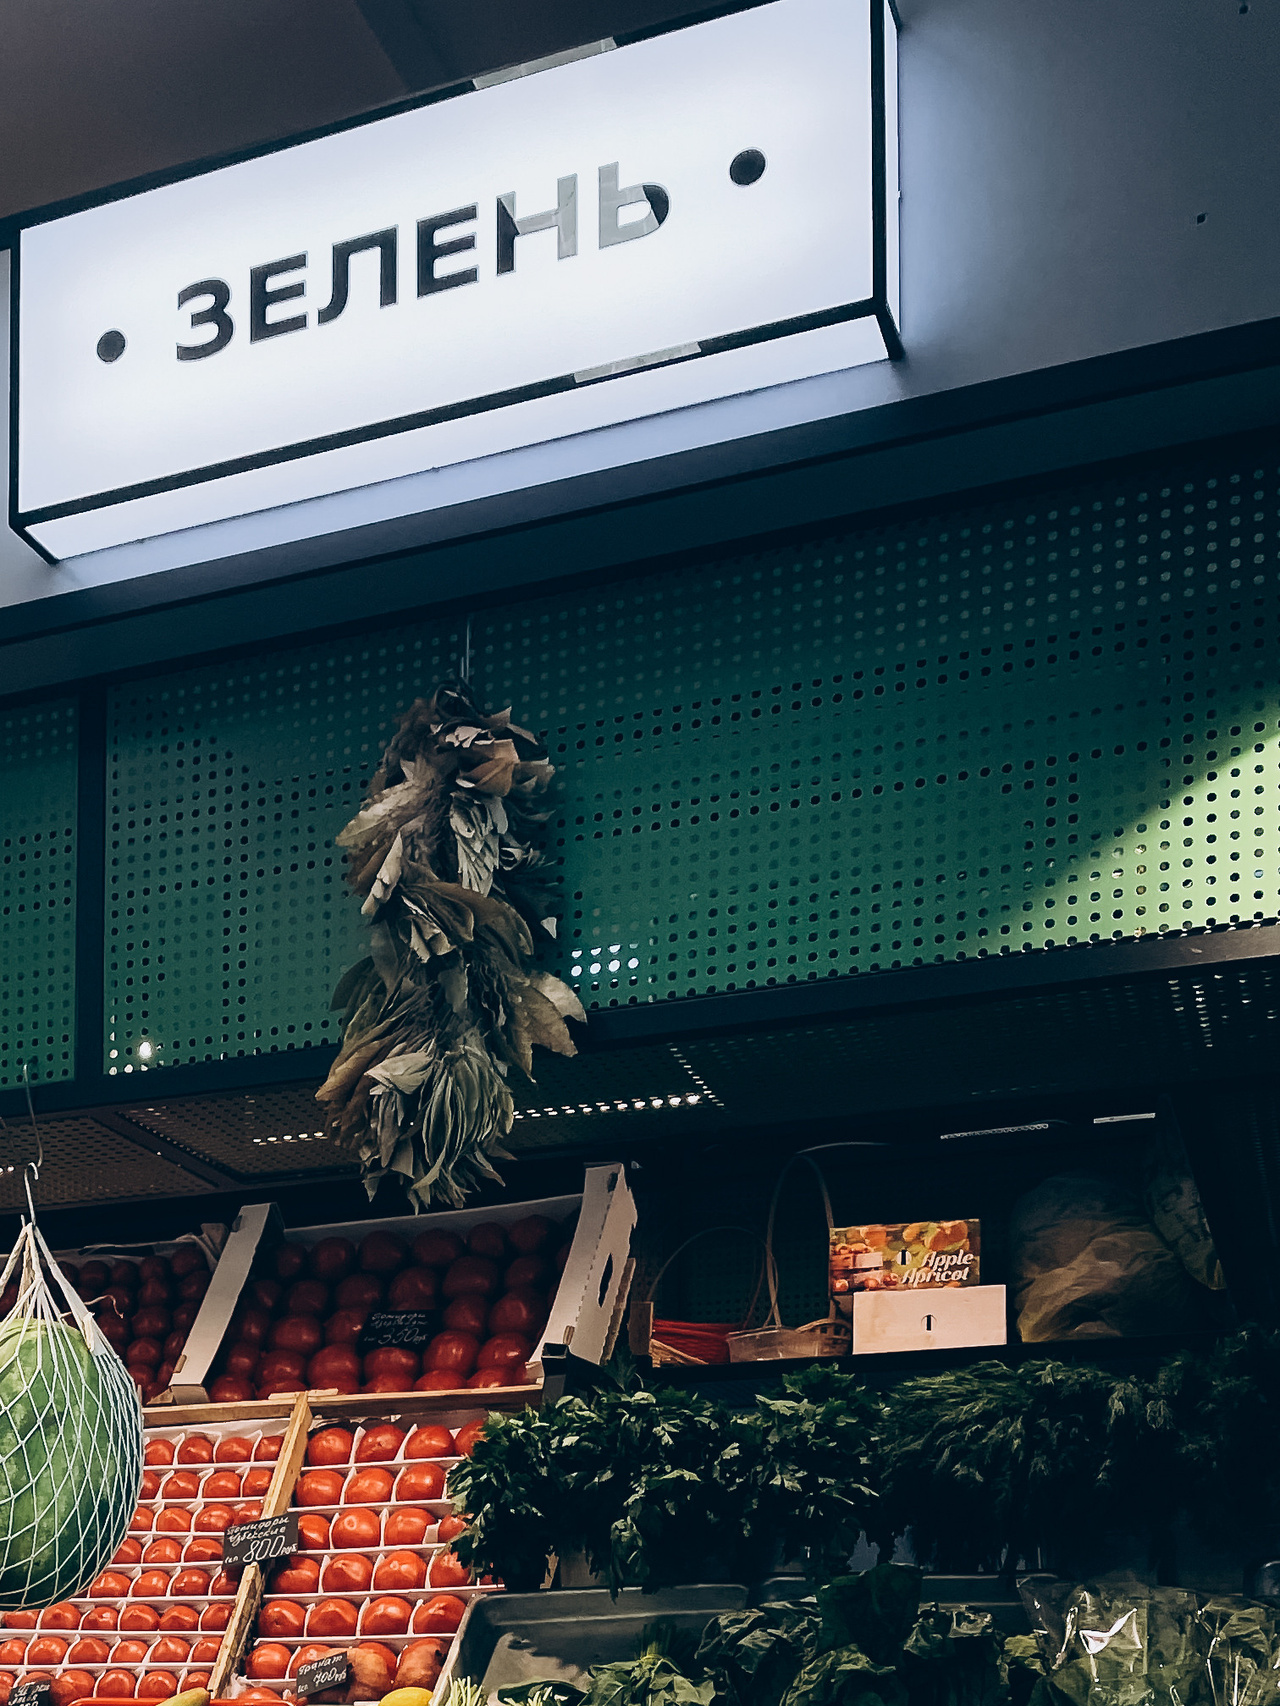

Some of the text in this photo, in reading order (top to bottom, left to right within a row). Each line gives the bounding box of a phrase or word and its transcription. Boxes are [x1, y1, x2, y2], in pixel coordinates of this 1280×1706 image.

[175, 161, 672, 362] ЗЕЛЕНЬ
[920, 1250, 974, 1269] Apple
[900, 1267, 970, 1286] Apricot
